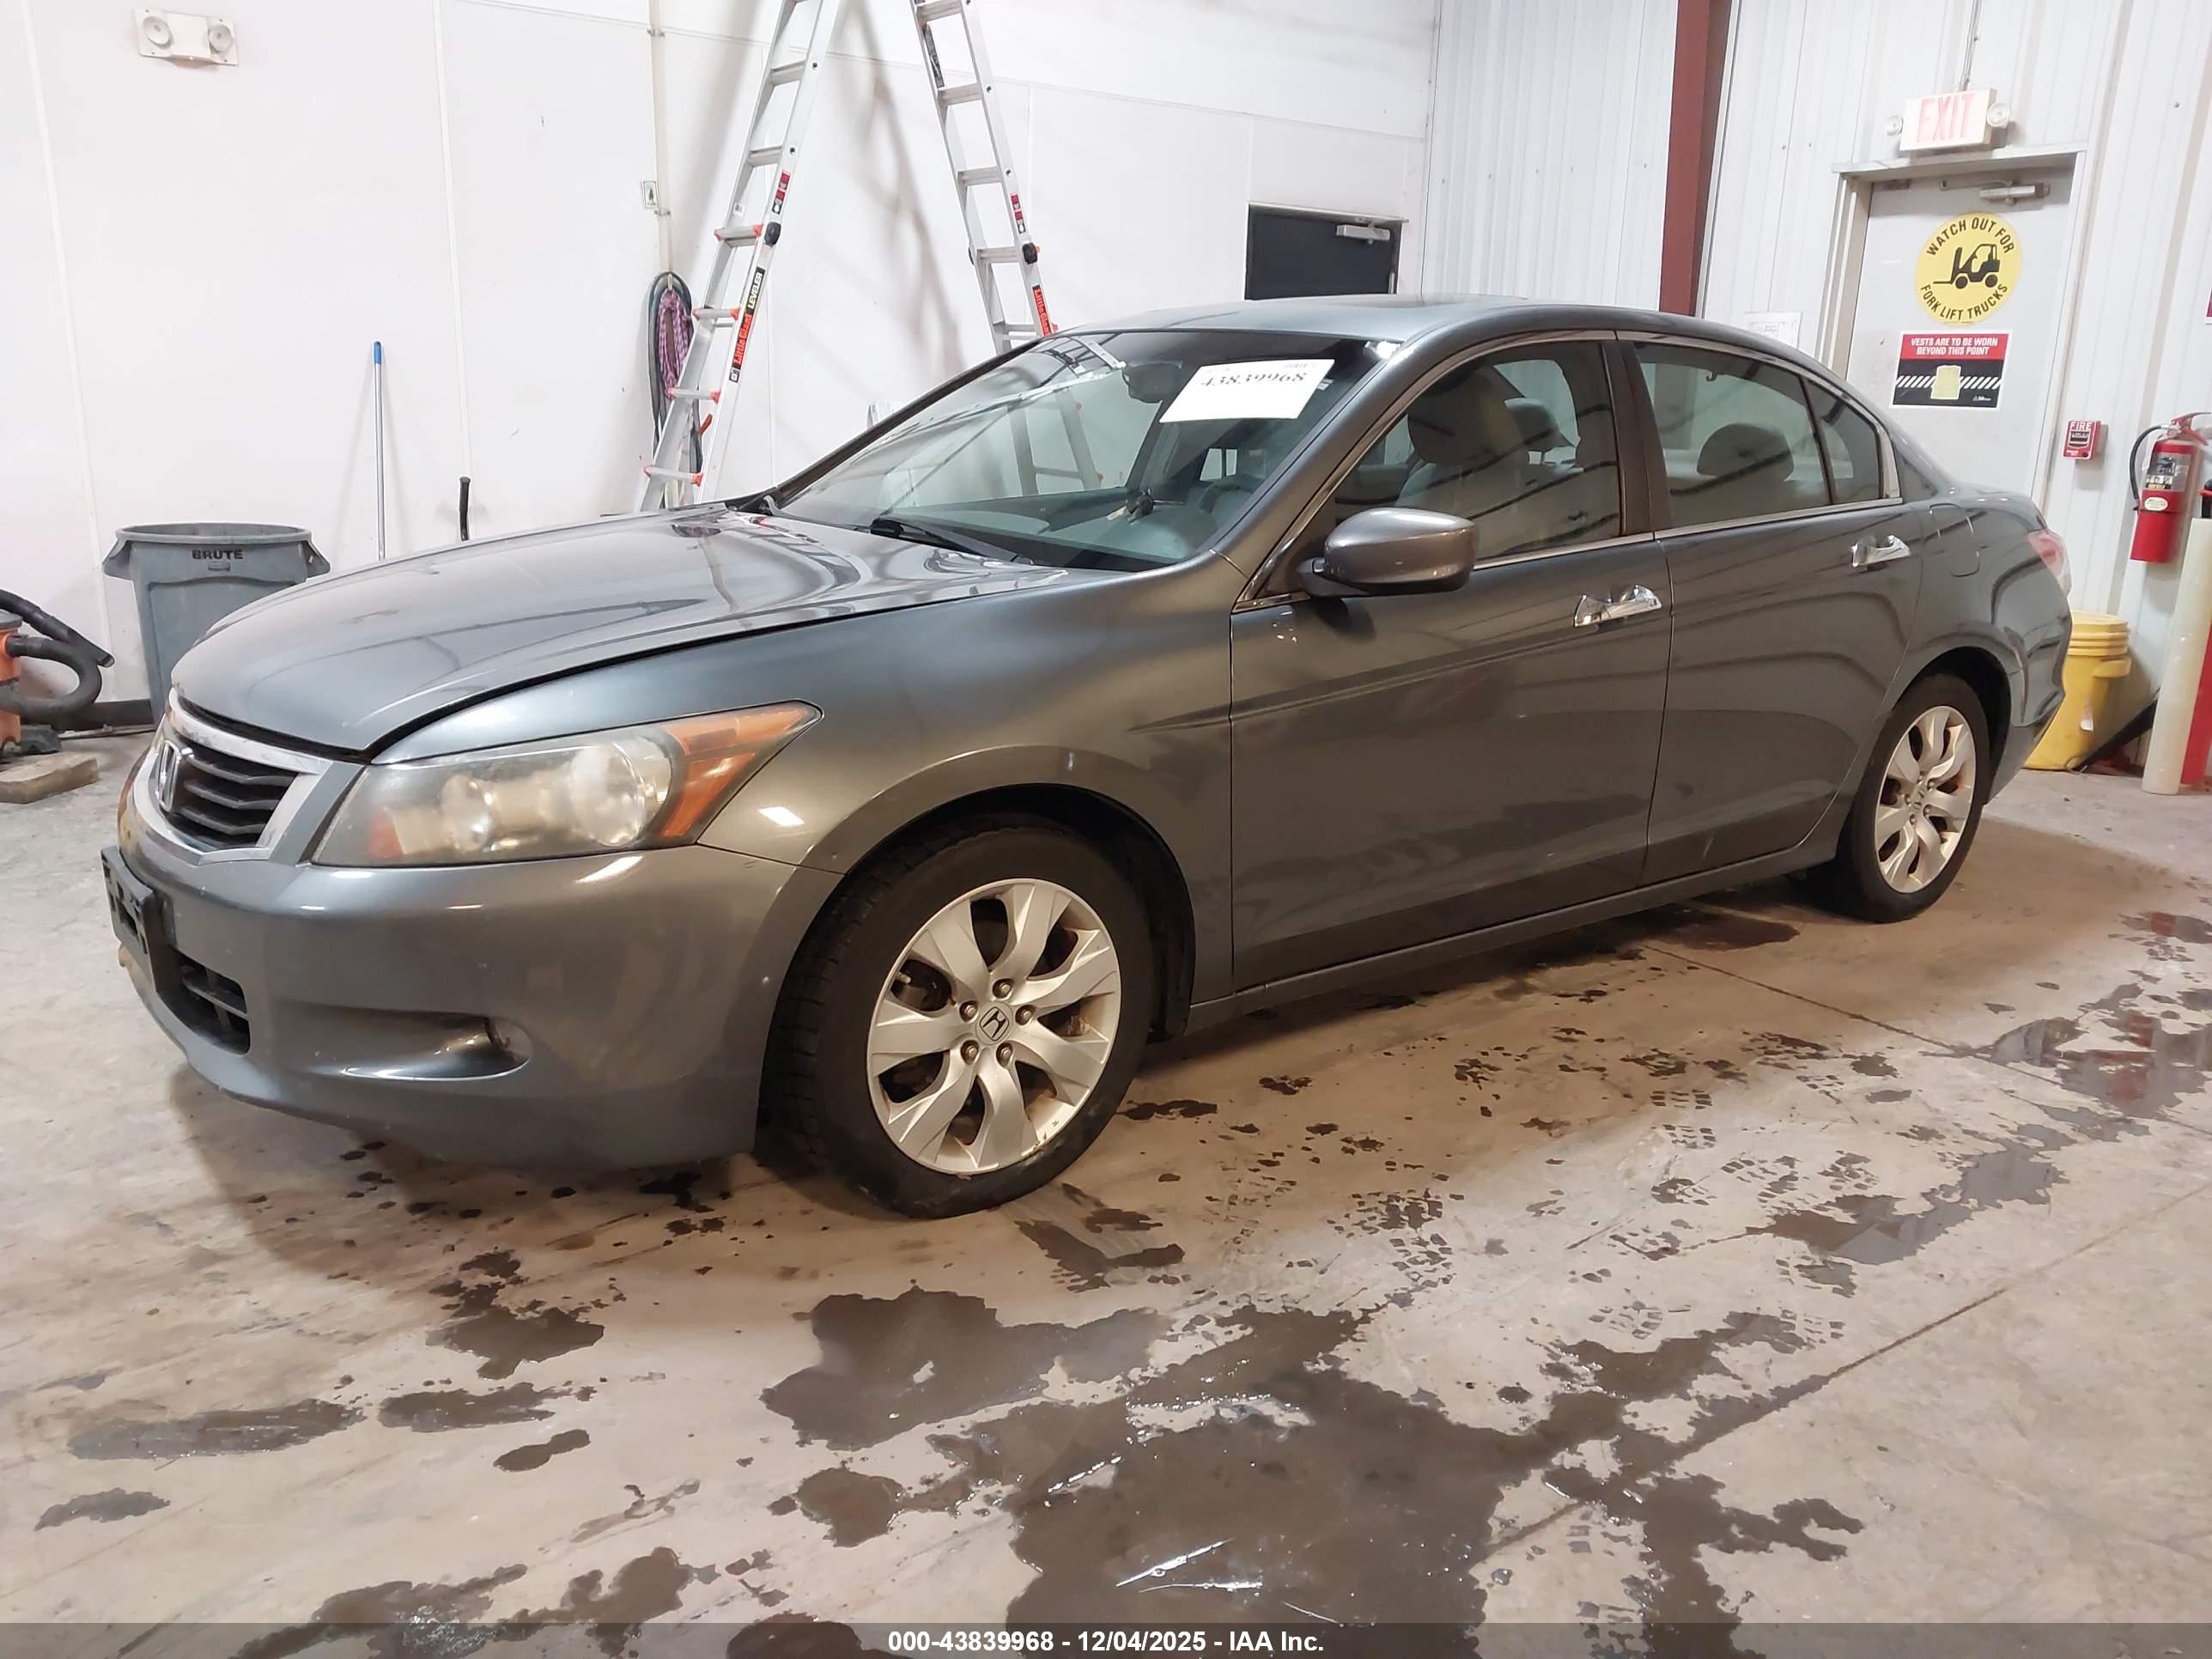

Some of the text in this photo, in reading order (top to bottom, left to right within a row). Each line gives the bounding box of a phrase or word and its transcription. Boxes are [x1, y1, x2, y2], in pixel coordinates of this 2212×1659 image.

[1916, 93, 1978, 143] EXIT
[1926, 216, 2014, 256] WATCH OUT FOR
[748, 272, 763, 308] LEVELER
[1920, 283, 2008, 320] FORK LIFT TRUCKS
[1911, 337, 1934, 346] VESTS
[1973, 337, 1998, 347] WORN
[1916, 346, 1990, 356] BEYOND THIS POINT
[1202, 372, 1307, 386] 43839968
[2070, 421, 2092, 430] FIRE
[192, 550, 243, 560] BRUTE
